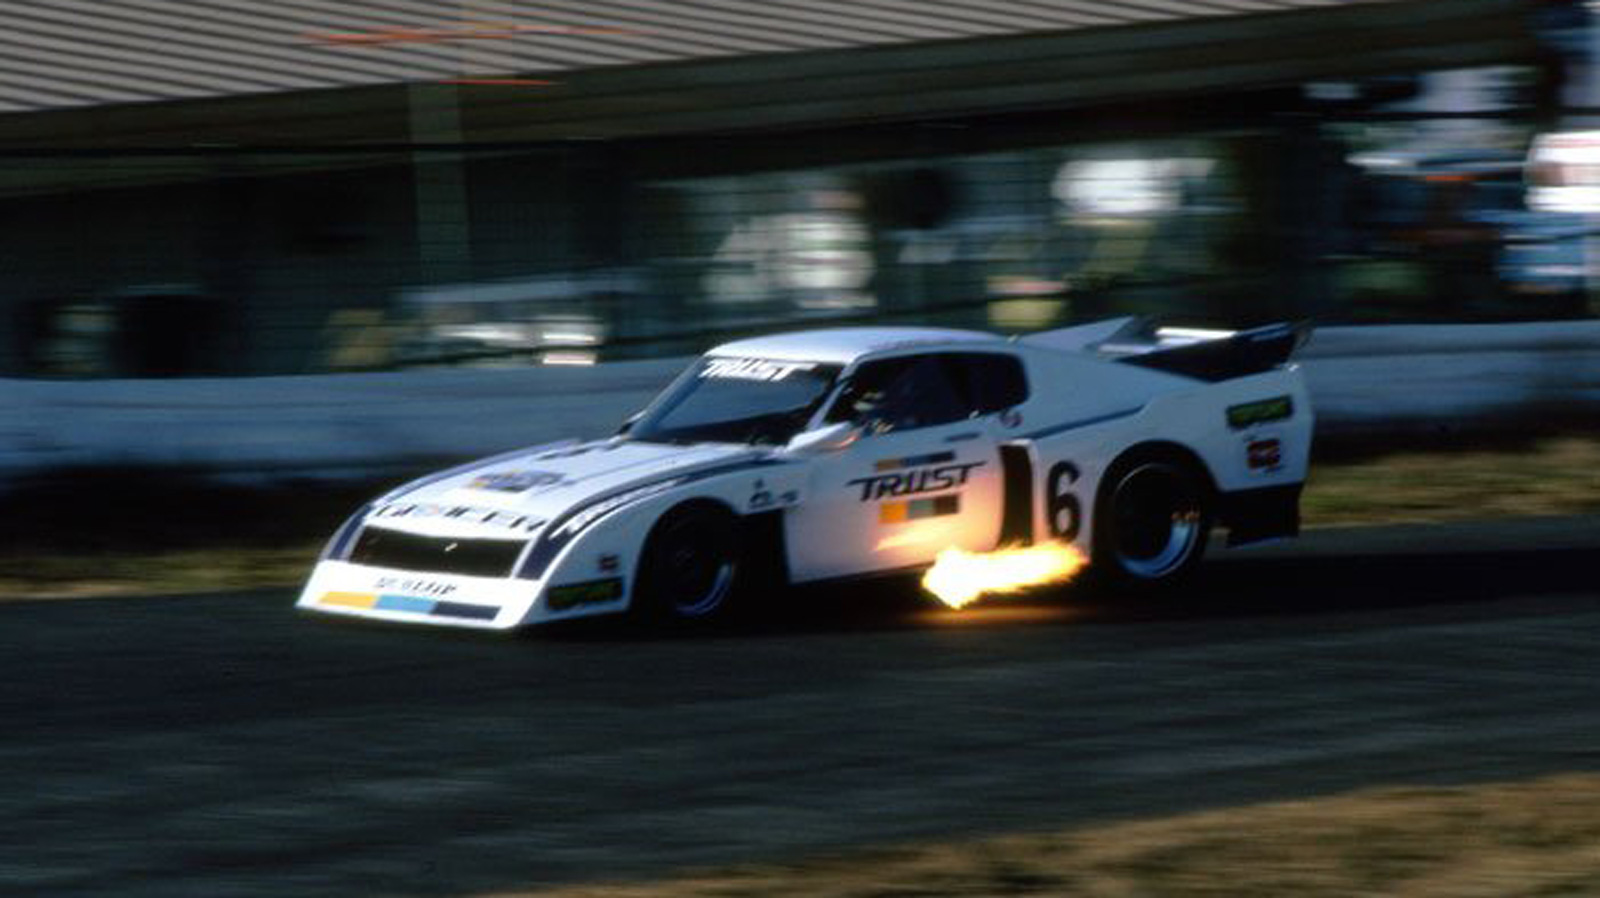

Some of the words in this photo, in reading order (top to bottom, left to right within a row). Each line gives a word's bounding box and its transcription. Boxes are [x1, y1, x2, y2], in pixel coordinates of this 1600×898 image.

[698, 358, 816, 382] TRUST
[846, 460, 987, 501] TRUST
[1046, 458, 1083, 544] 6
